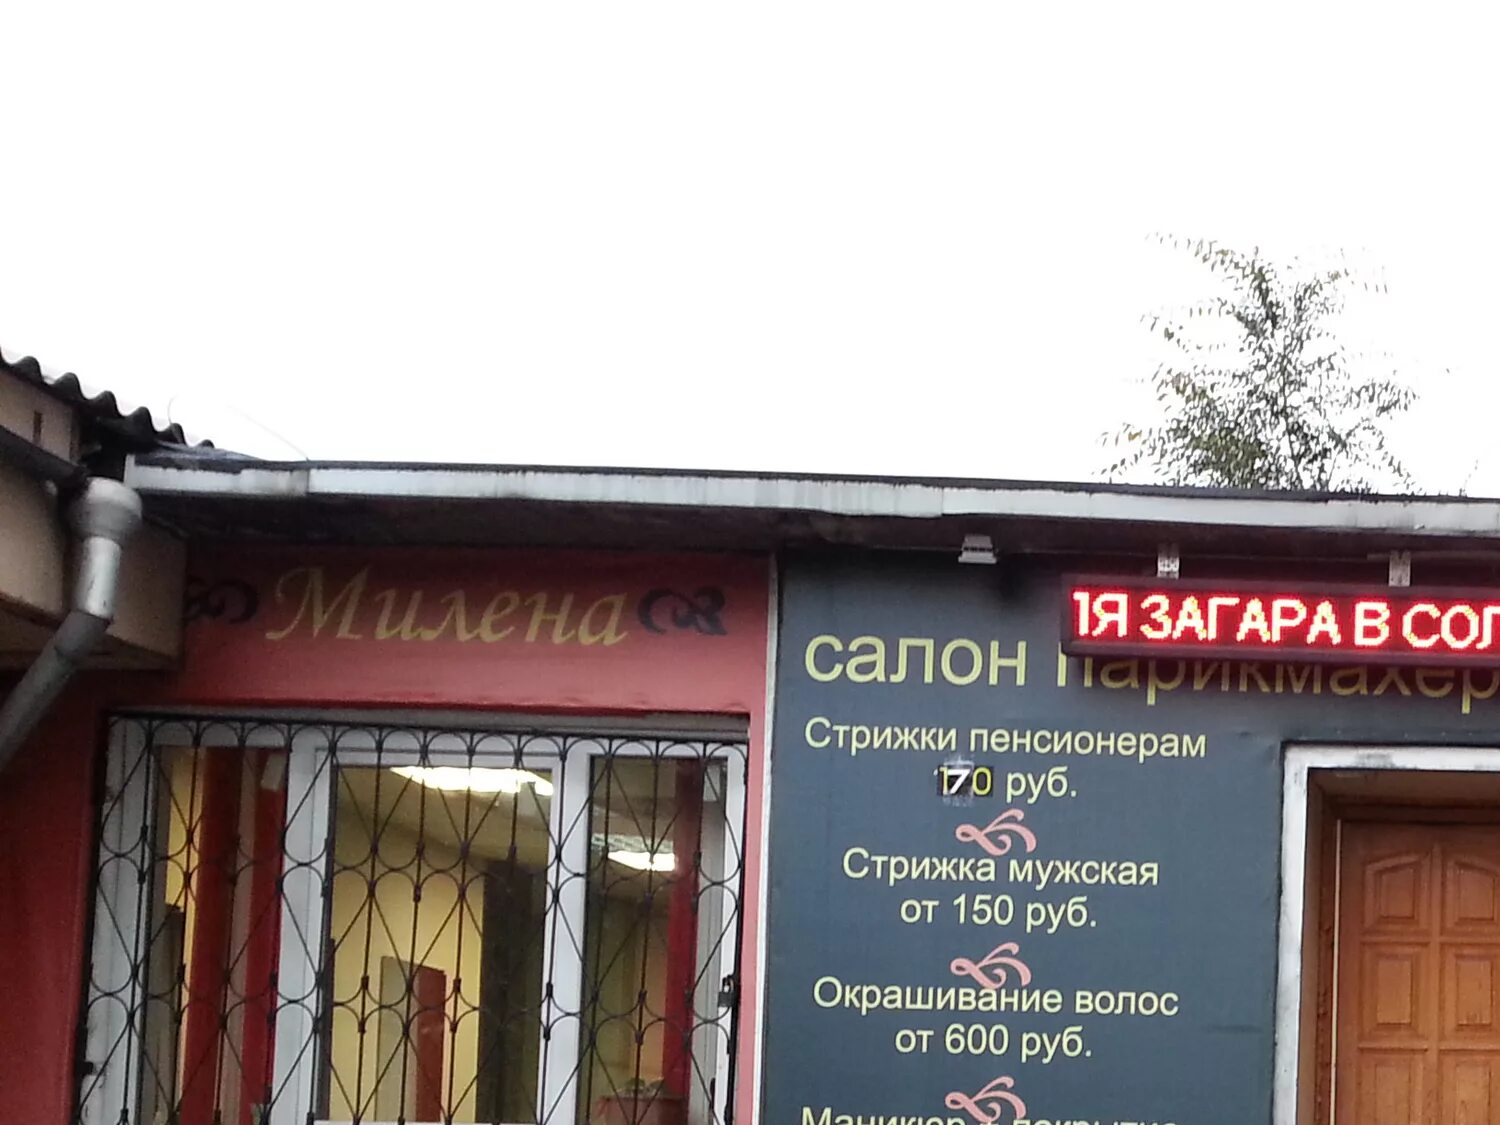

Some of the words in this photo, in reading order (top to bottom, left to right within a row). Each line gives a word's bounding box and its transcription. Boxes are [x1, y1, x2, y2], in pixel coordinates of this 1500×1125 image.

[265, 565, 629, 647] Милена
[1140, 595, 1342, 645] ЗАГАРА
[1353, 599, 1391, 648] В
[805, 635, 1027, 686] салон
[805, 716, 957, 757] Стрижки
[969, 729, 1206, 764] пенсионерам
[1006, 765, 1077, 804] руб.
[843, 847, 997, 887] Стрижка
[1009, 860, 1159, 891] мужская
[900, 899, 940, 923] от
[953, 893, 1014, 926] 150
[1026, 895, 1097, 934] руб.
[812, 976, 1063, 1015] Окрашивание
[1075, 990, 1179, 1016] волос
[895, 1029, 935, 1053] от
[945, 1023, 1009, 1055] 600
[1021, 1025, 1092, 1064] руб.
